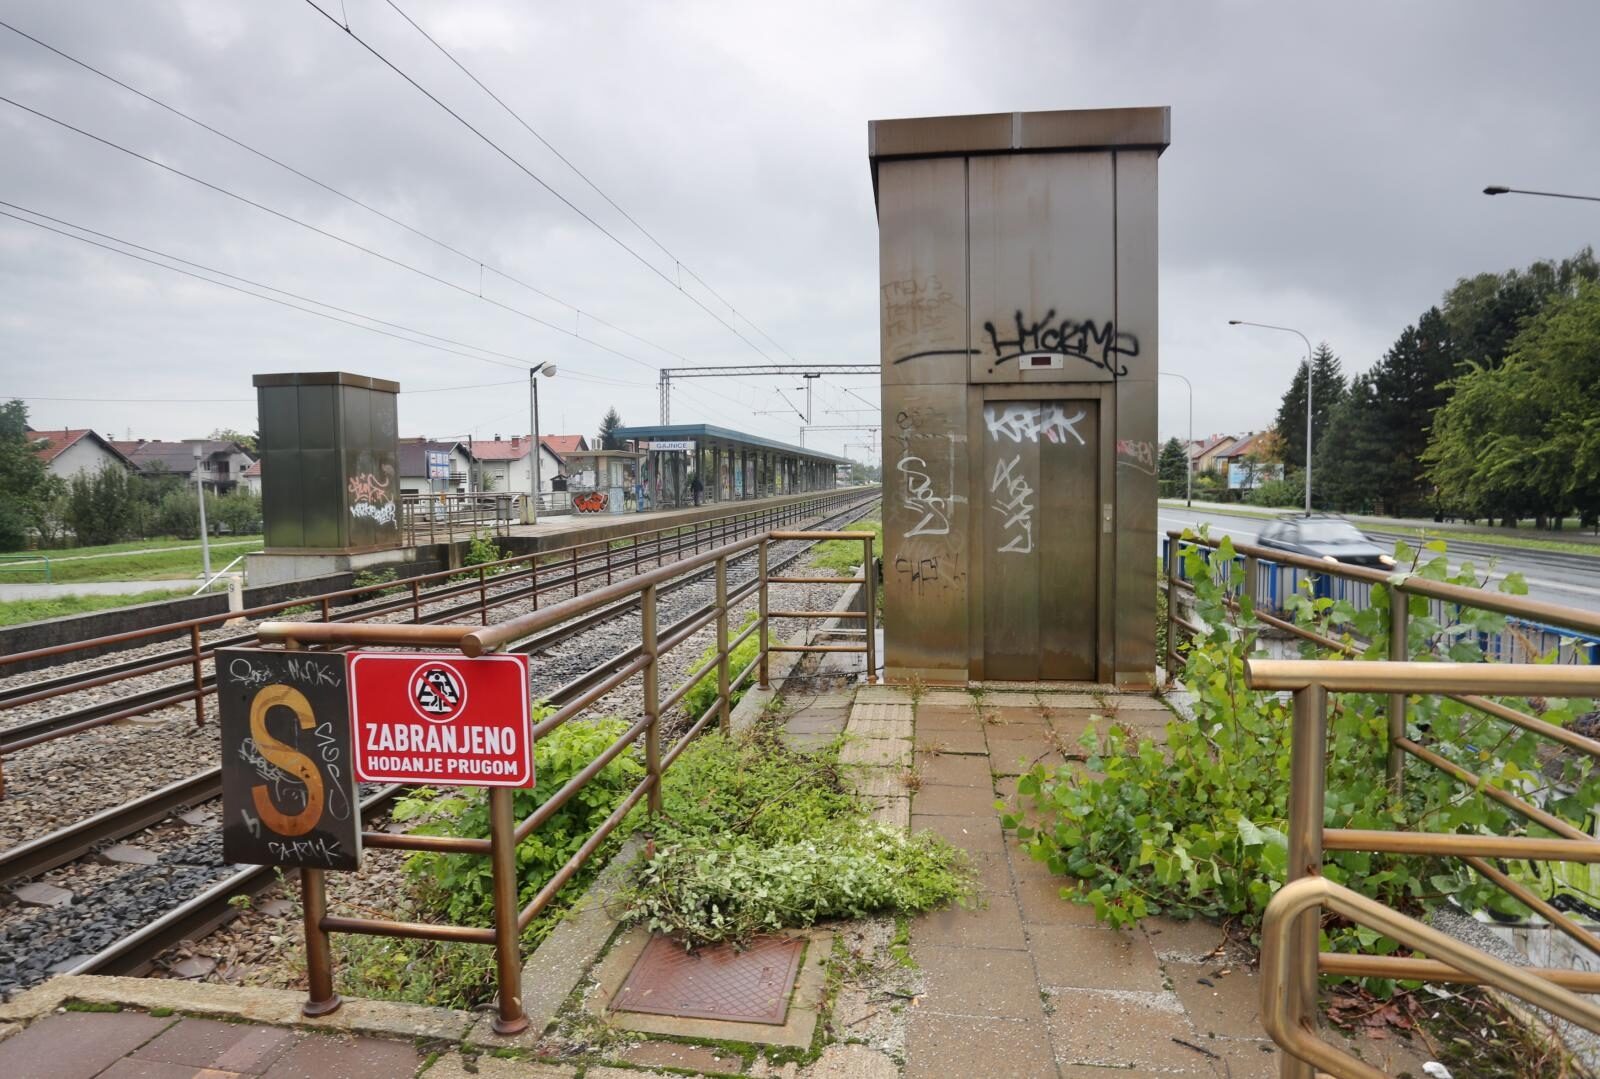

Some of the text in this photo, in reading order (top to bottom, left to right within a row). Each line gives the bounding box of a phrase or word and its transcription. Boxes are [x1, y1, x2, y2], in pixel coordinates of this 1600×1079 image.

[366, 723, 516, 755] ZABRANJENO
[249, 683, 325, 837] S
[367, 756, 518, 776] HODANJE PRUGOM
